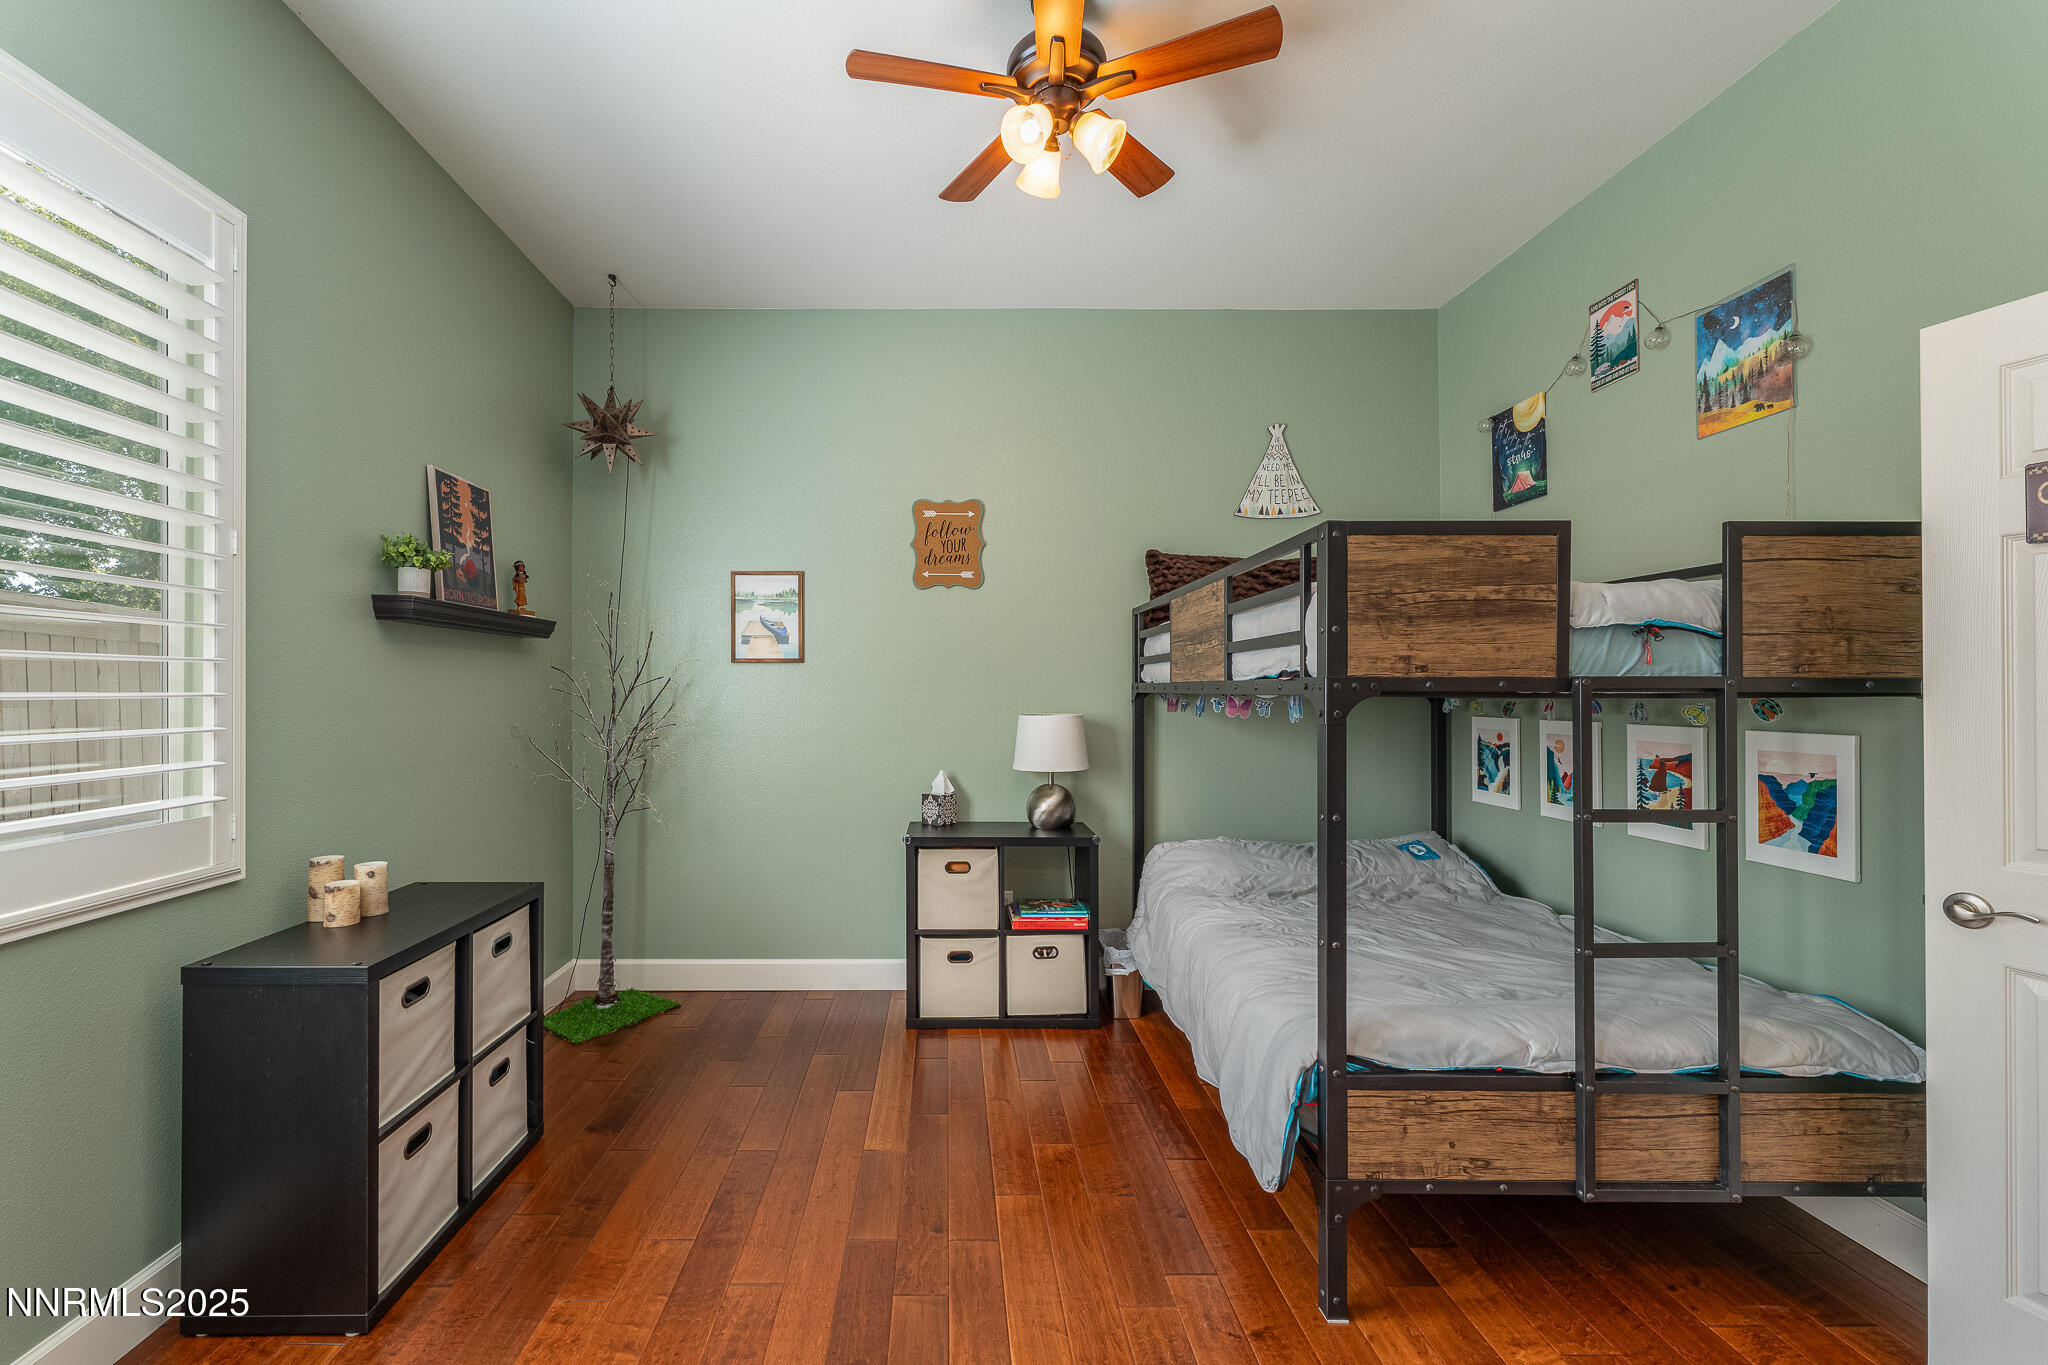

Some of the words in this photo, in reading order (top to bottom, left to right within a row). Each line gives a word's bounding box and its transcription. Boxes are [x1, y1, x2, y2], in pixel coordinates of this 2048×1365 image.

[1270, 444, 1285, 452] YOU
[1262, 463, 1280, 472] NEED
[1283, 462, 1294, 471] ME
[1274, 474, 1286, 488] BE
[1289, 473, 1301, 486] IN
[1245, 488, 1264, 503] MY
[1268, 487, 1309, 505] TEEPEE
[924, 519, 975, 546] follow
[940, 537, 967, 554] YOUR
[923, 548, 971, 567] dreams
